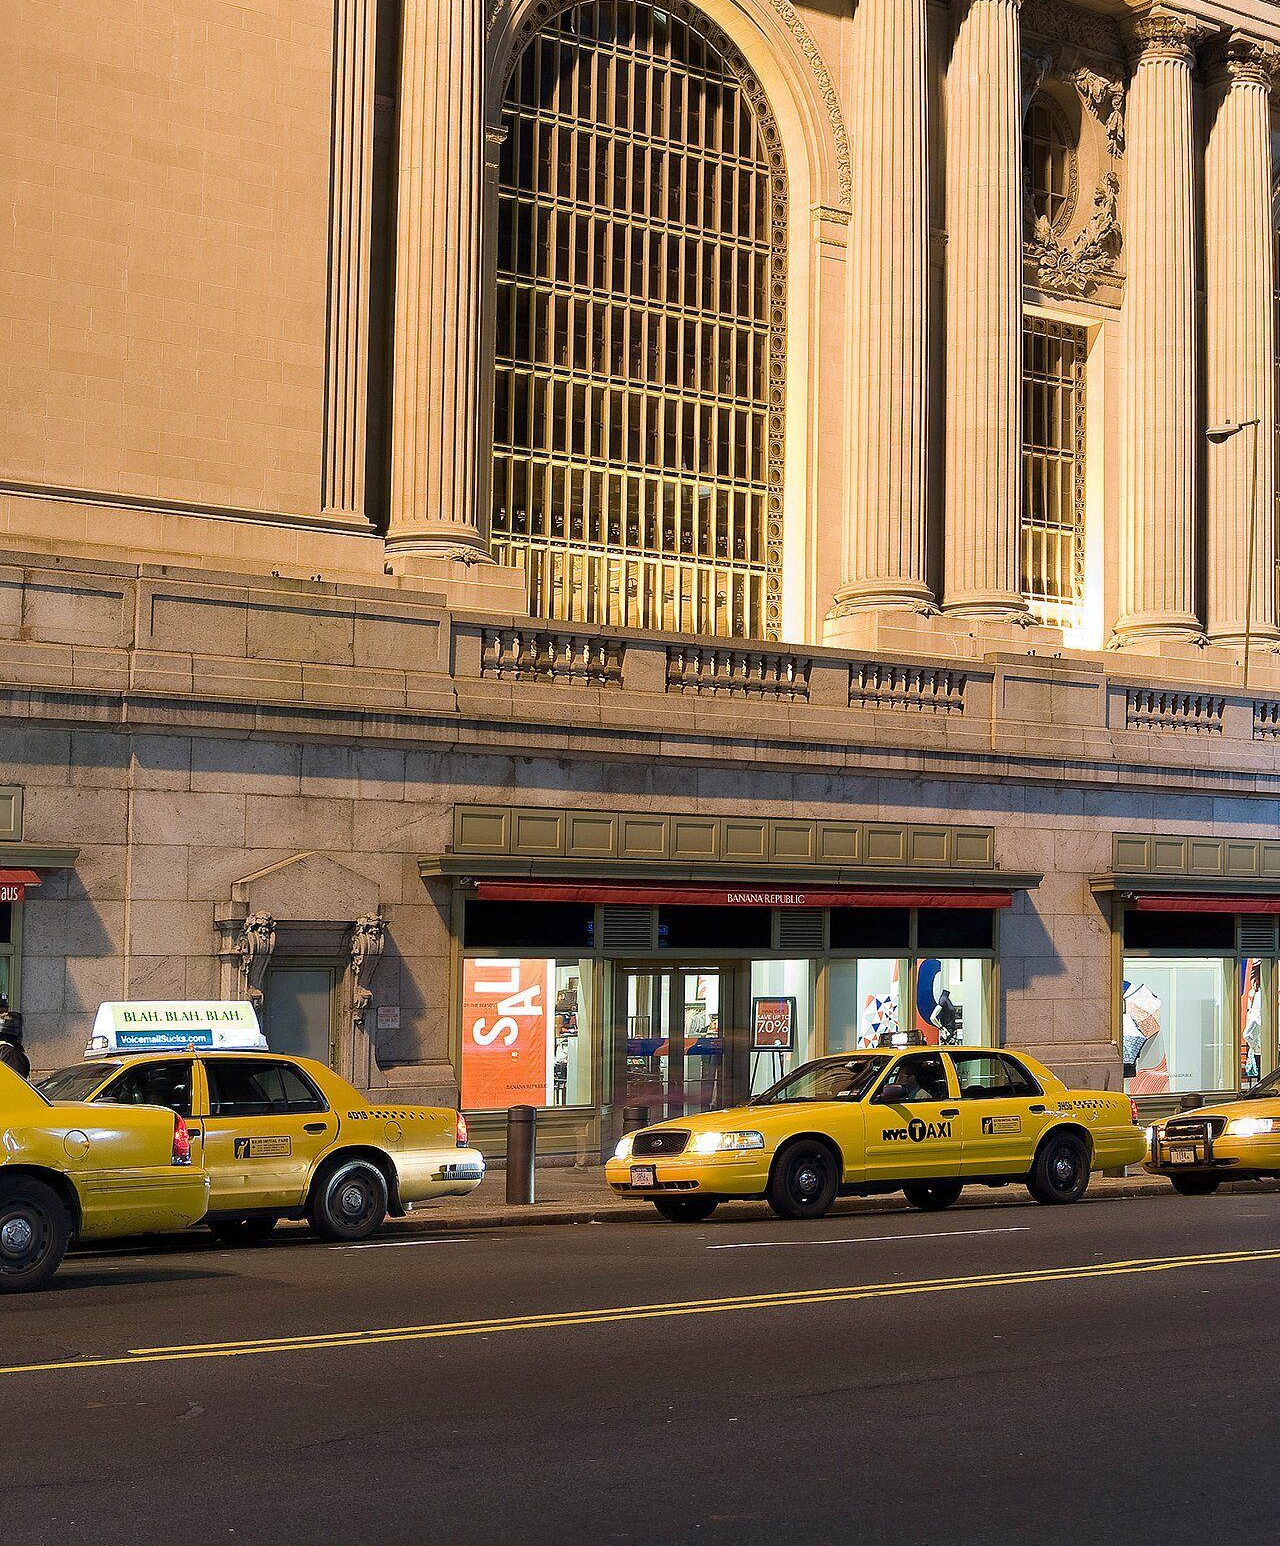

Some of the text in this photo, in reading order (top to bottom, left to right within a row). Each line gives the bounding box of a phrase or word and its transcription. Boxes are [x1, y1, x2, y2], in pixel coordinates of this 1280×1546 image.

[727, 893, 805, 904] BANANA REPUBLIC
[123, 1010, 243, 1022] BLAH. BLAH. BLAH.
[120, 1034, 207, 1044] VoicemailSucks.com
[347, 1111, 368, 1120] 4D18
[882, 1118, 952, 1143] NYC TAXI
